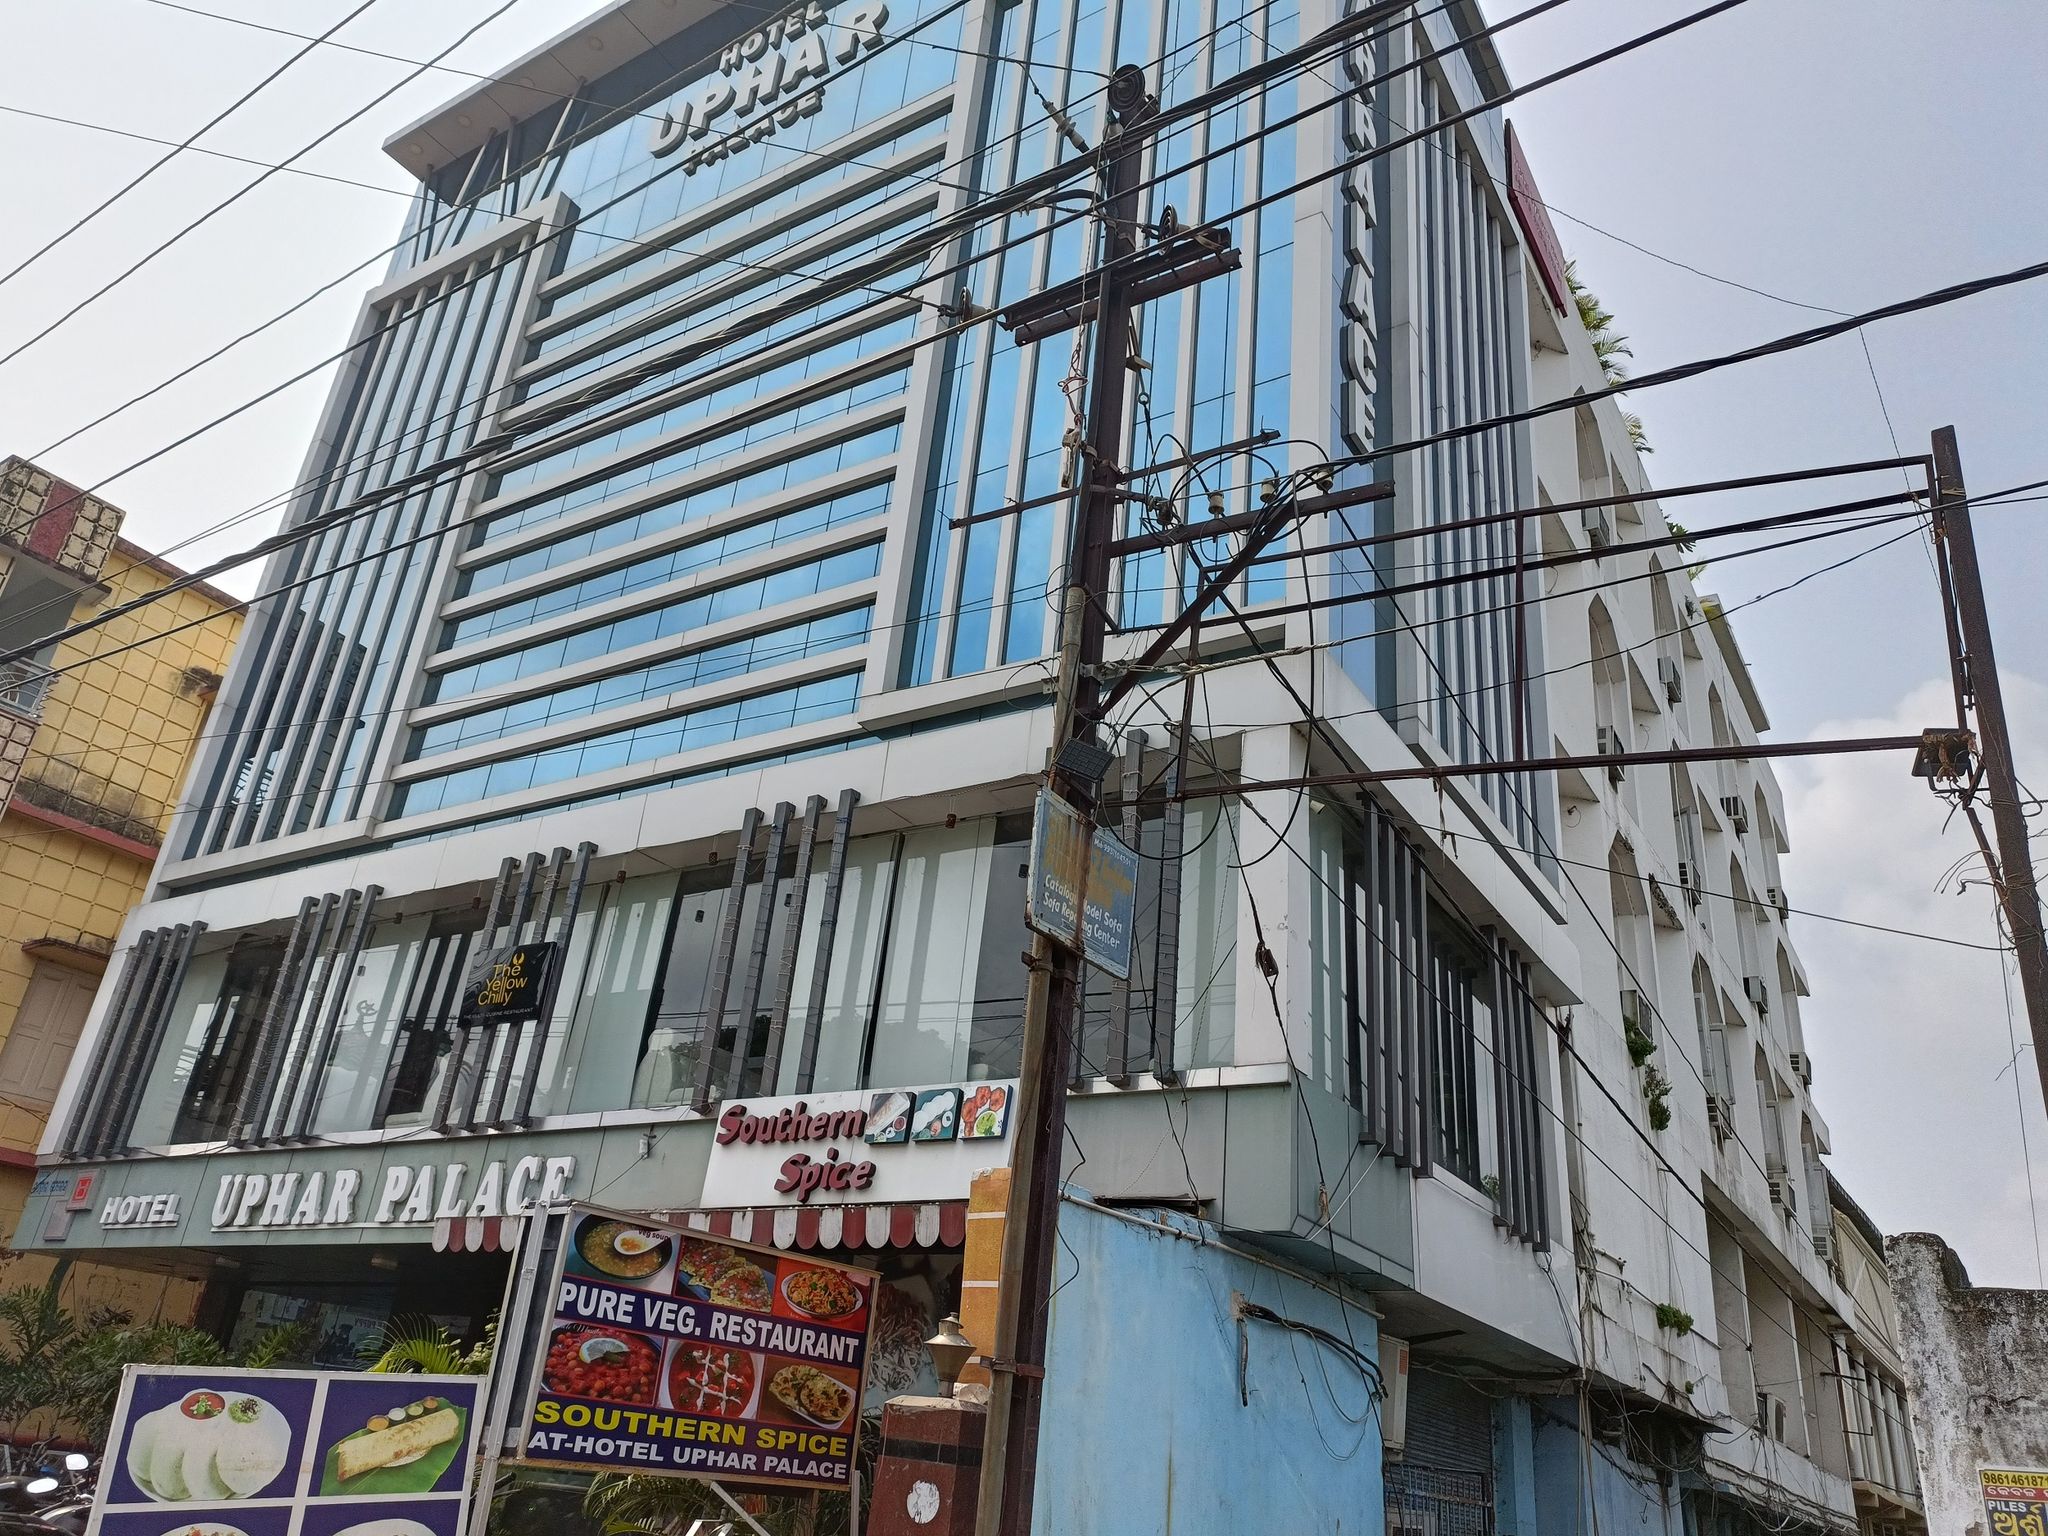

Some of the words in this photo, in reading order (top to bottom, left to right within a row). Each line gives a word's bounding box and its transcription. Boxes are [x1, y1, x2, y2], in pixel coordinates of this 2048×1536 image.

[719, 1, 828, 77] HOTEL
[650, 0, 889, 159] UPHAR
[1340, 94, 1378, 464] PALACE
[1043, 892, 1061, 912] Sofa
[1094, 923, 1120, 949] Center
[1104, 912, 1122, 934] Sofa
[478, 989, 513, 1006] Chilly
[486, 976, 528, 991] Yellow
[493, 963, 521, 978] The
[716, 1100, 868, 1146] Southern
[99, 1194, 182, 1225] HOTEL
[211, 1169, 361, 1227] UPHAR
[374, 1155, 576, 1224] PALACE
[773, 1147, 876, 1203] Spice
[557, 1281, 636, 1324] PURE
[644, 1298, 701, 1335] VEG.
[709, 1311, 859, 1364] RESTAURANT
[527, 1431, 665, 1461] AT-HOTEL
[673, 1446, 757, 1471] UPHAR
[763, 1456, 847, 1479] PALACE
[534, 1400, 746, 1446] SOUTHERN
[756, 1428, 848, 1457] SPICE
[1988, 1501, 2027, 1512] PILES
